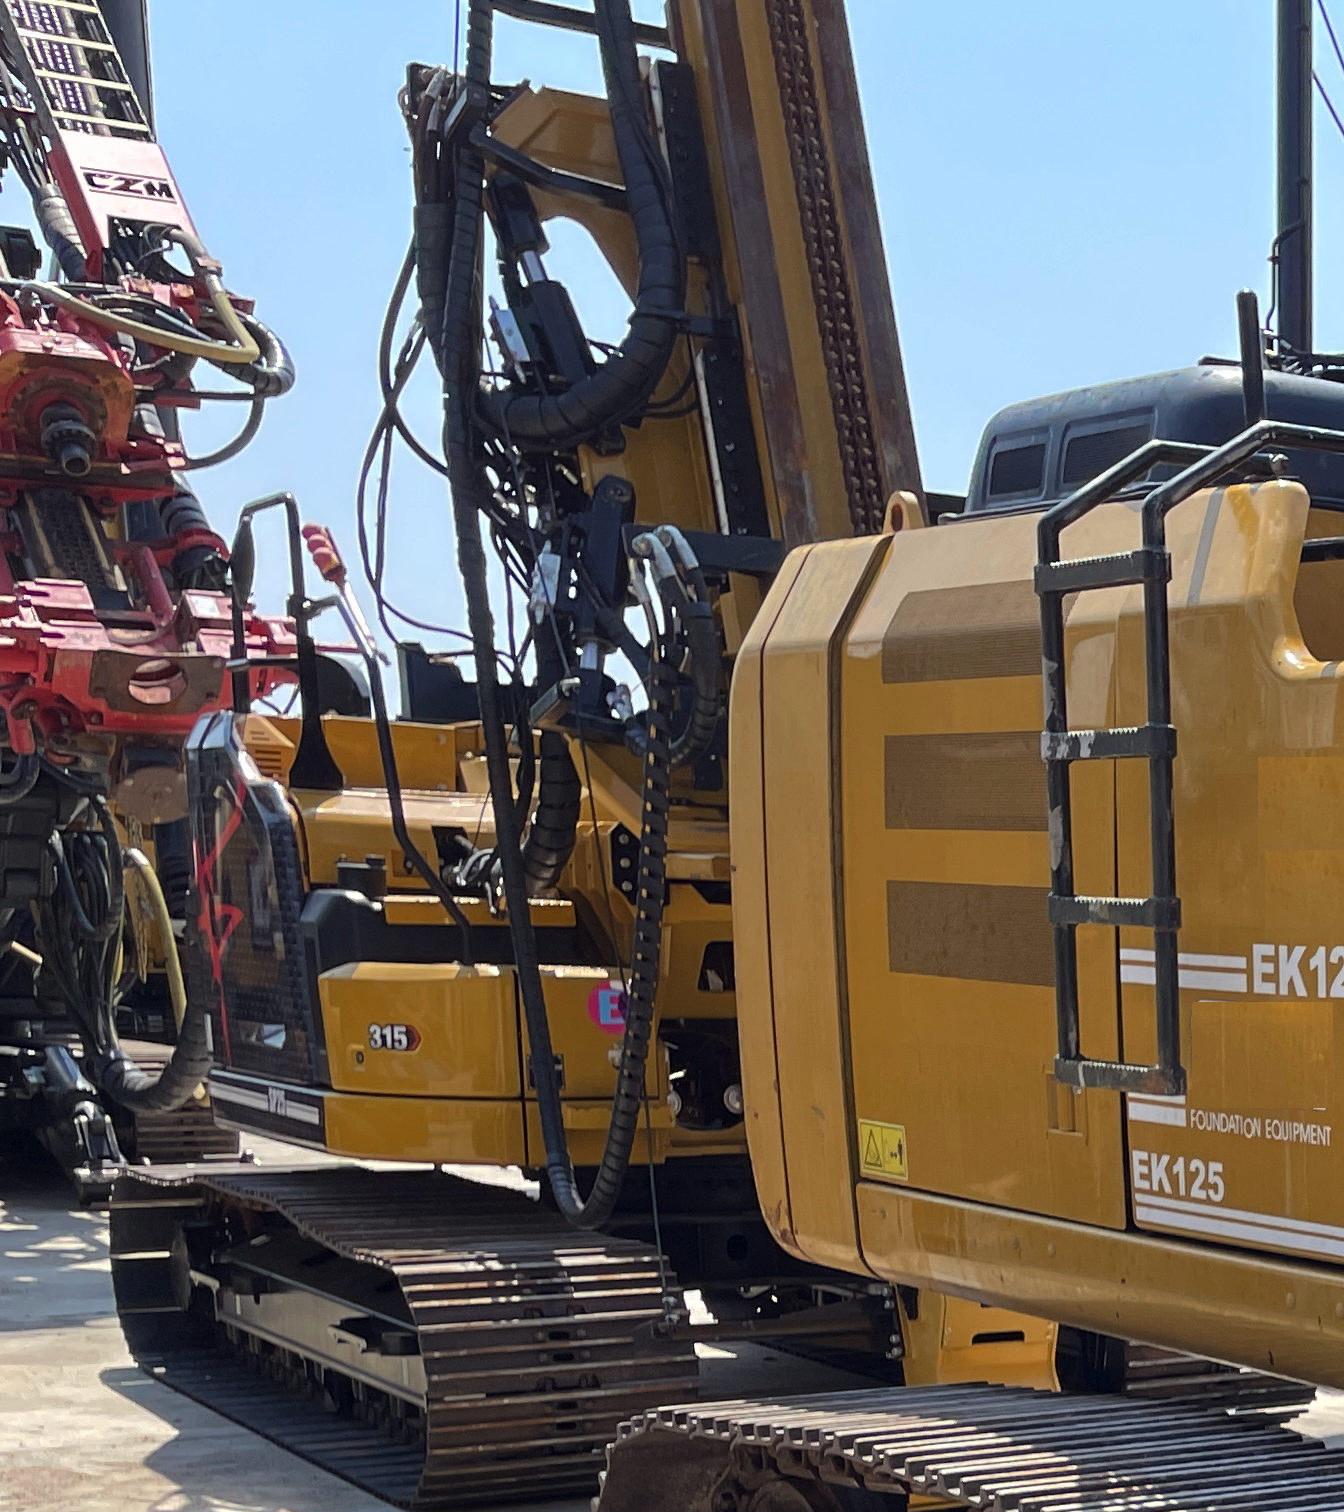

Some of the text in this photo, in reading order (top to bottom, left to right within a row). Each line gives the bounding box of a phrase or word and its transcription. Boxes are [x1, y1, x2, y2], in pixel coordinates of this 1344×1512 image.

[83, 171, 175, 200] CZM
[369, 1024, 408, 1051] 315
[1190, 1109, 1332, 1146] FOUNDATION EQUIPMENT
[1132, 1149, 1225, 1202] EK125
